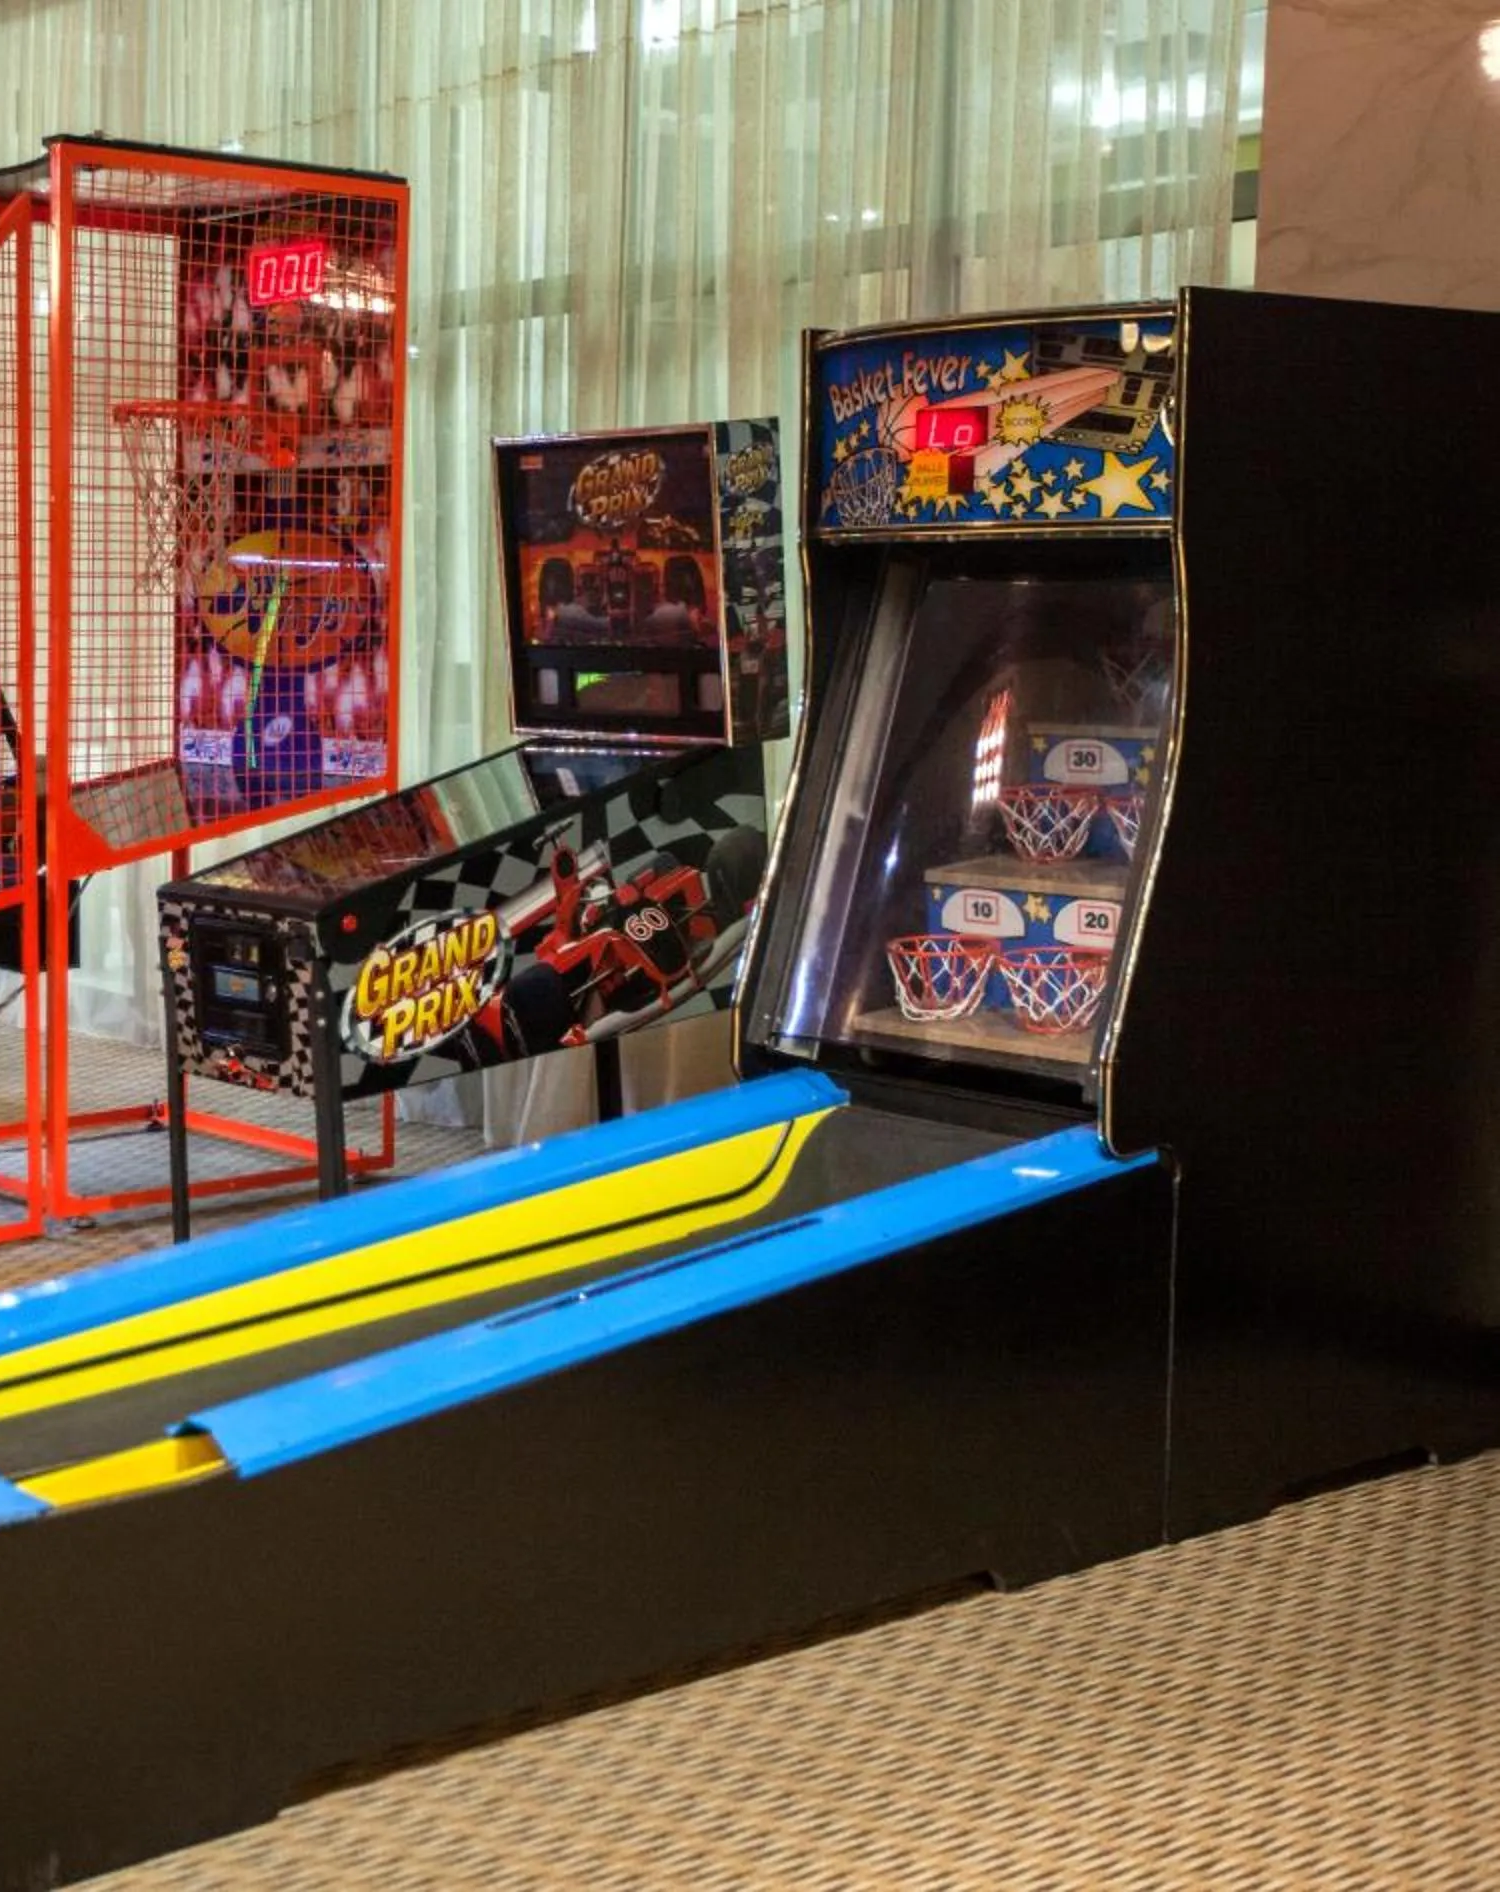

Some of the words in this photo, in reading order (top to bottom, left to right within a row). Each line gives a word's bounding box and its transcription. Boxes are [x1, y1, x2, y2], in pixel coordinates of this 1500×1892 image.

[257, 251, 322, 299] 000
[830, 368, 894, 423] Basket
[903, 351, 972, 395] Fever
[576, 453, 657, 496] GRAND
[590, 484, 648, 517] PRIX
[1073, 751, 1097, 768] 30
[625, 907, 669, 942] 60
[971, 901, 993, 919] 10
[1085, 912, 1110, 929] 20
[355, 912, 497, 1018] GRAND
[381, 969, 483, 1063] PRIX
